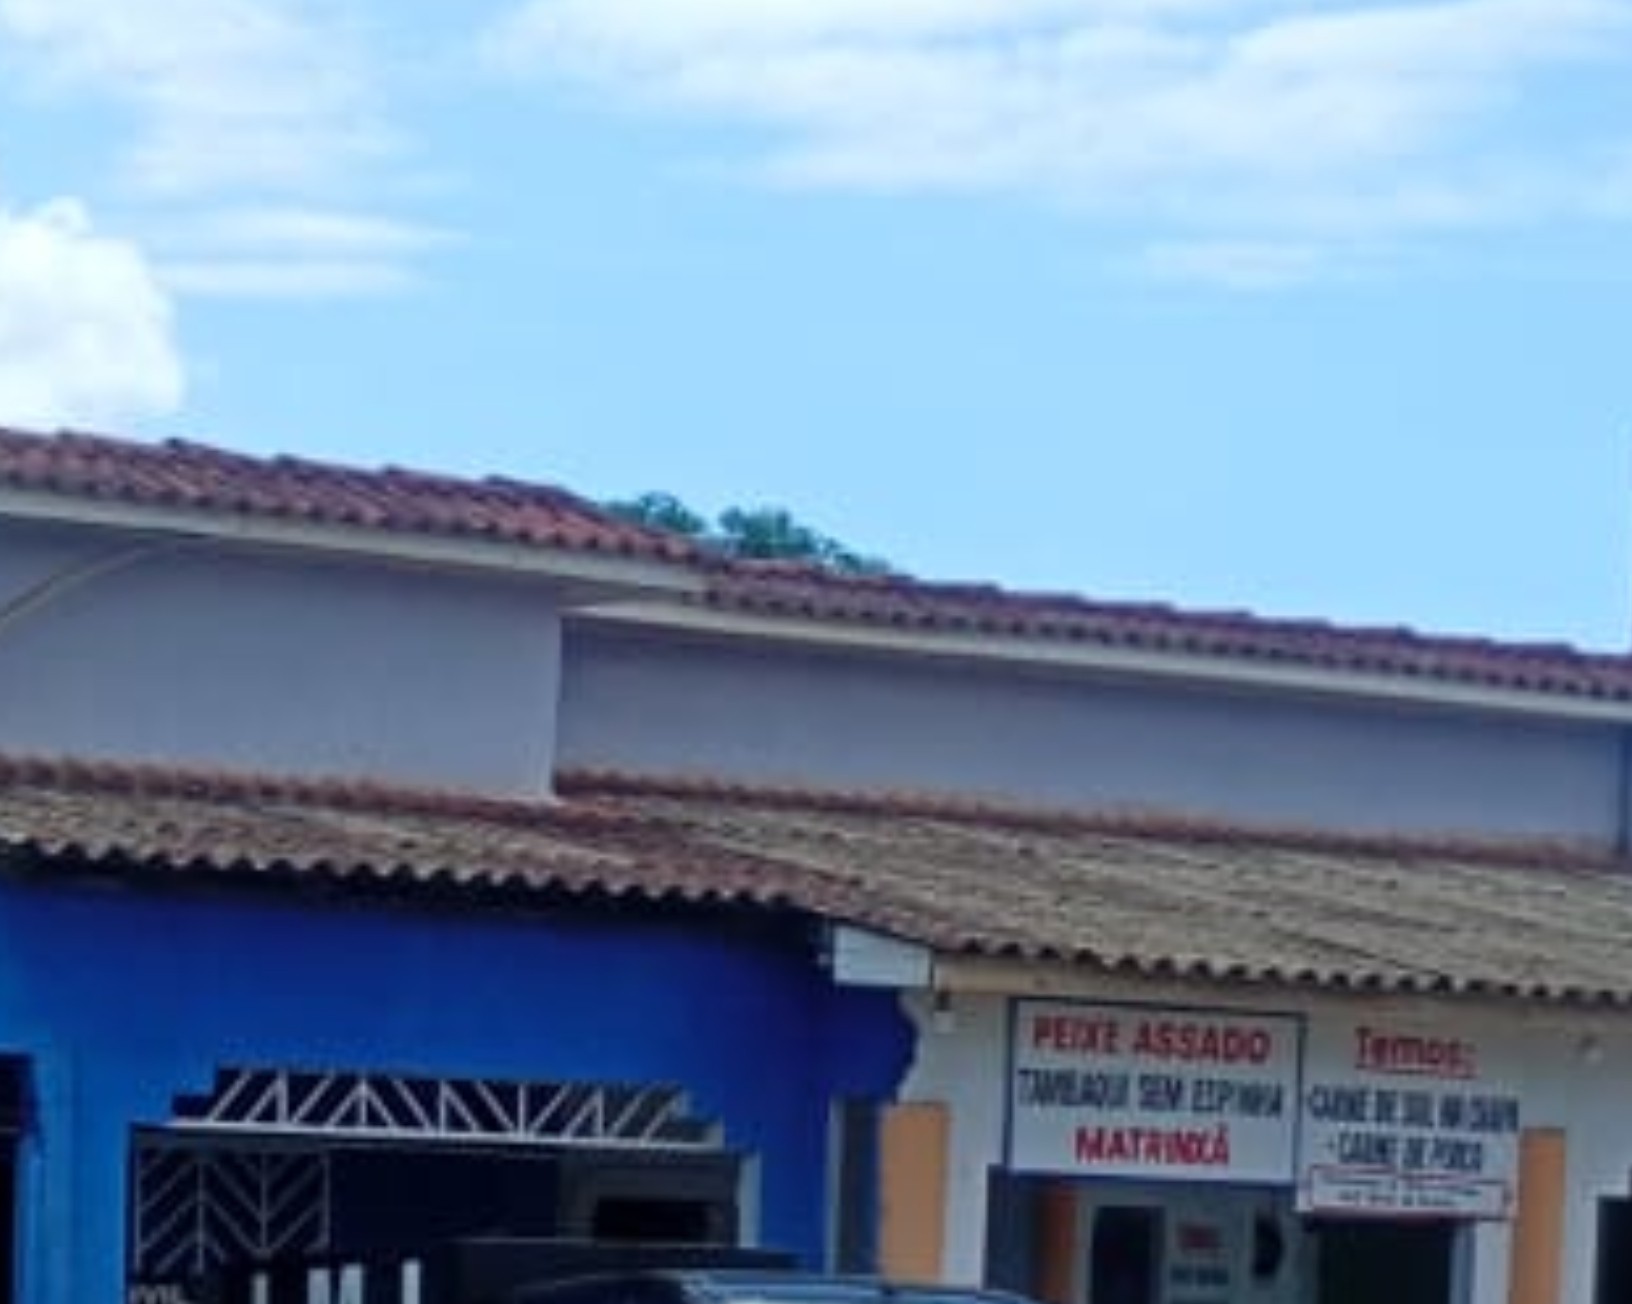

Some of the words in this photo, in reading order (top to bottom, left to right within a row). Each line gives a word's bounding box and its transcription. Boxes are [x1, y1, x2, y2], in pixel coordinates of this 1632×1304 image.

[1032, 1014, 1119, 1054] PEIXE
[1134, 1020, 1272, 1065] ASSADO
[1140, 1073, 1183, 1112] SEM
